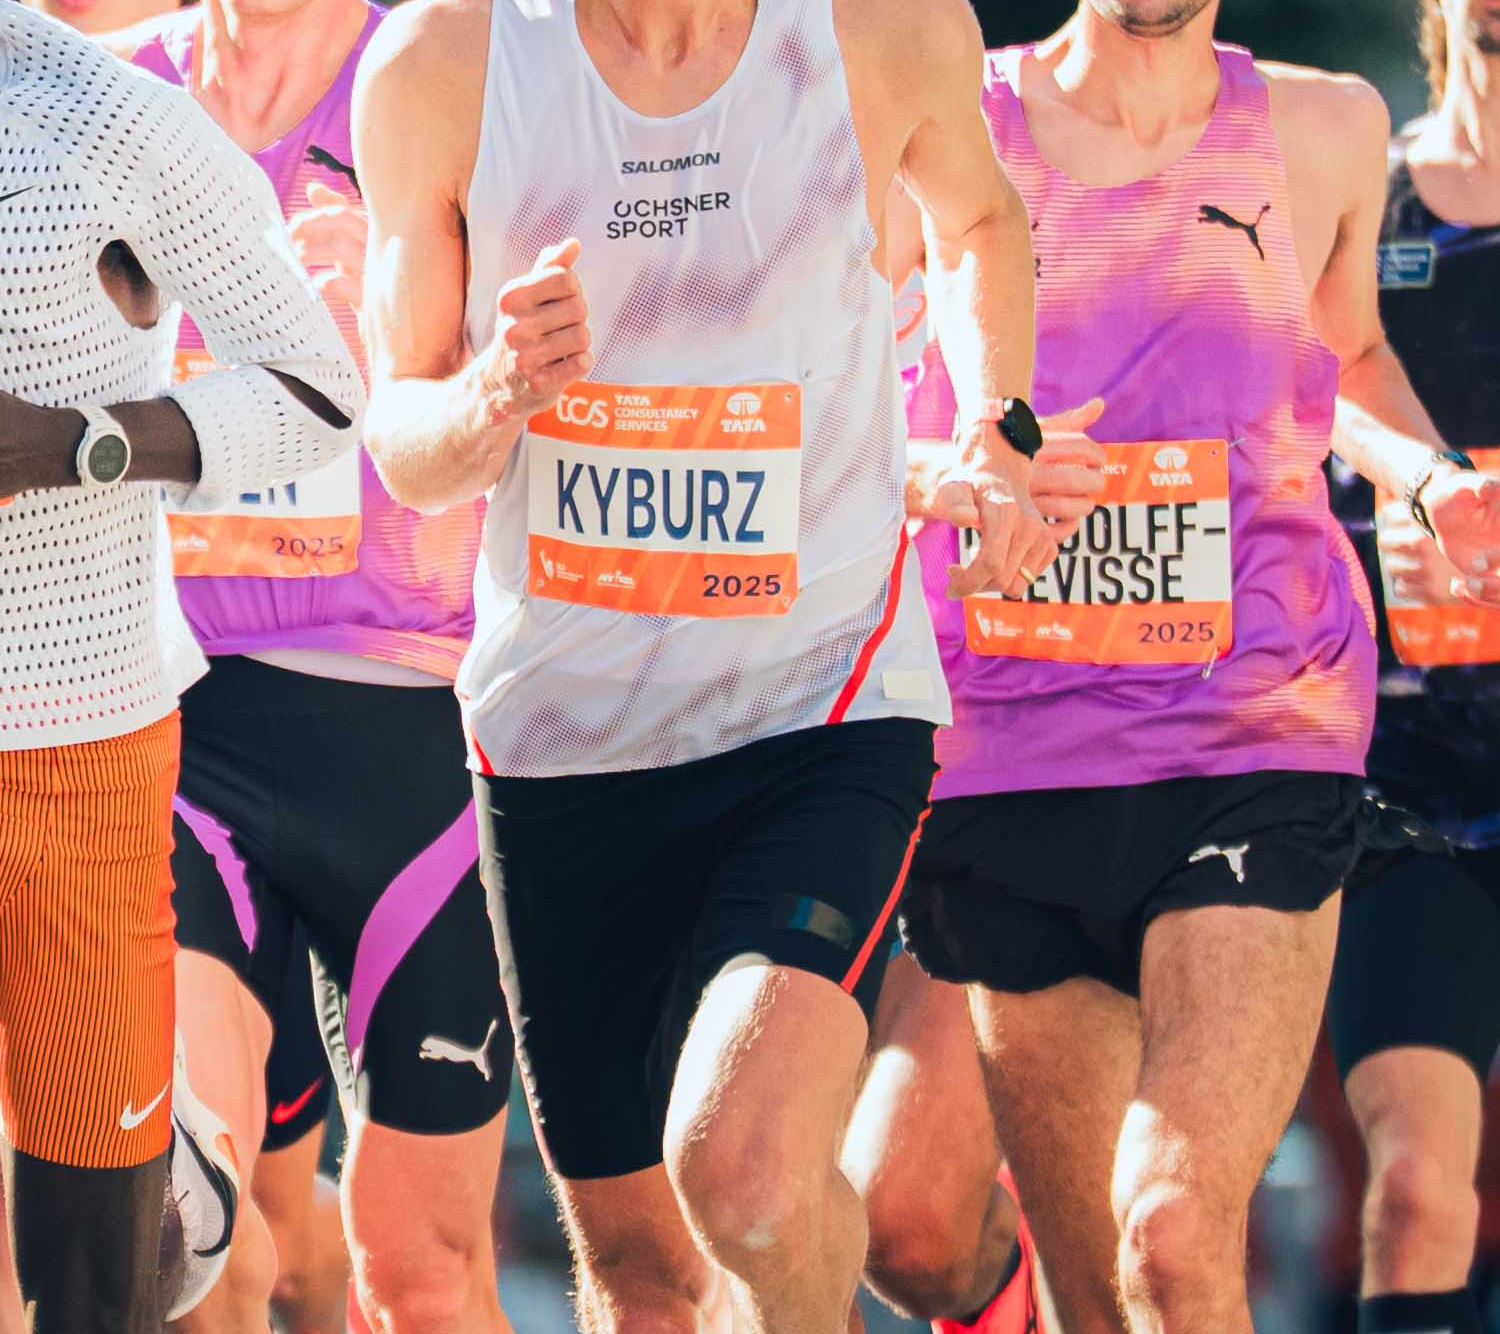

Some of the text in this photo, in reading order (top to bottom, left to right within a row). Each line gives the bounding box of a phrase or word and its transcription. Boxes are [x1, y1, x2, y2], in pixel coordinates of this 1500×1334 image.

[621, 152, 720, 174] SALOMON
[613, 191, 730, 218] OCHSNER
[606, 218, 688, 239] SPORT
[615, 394, 650, 406] TATA
[614, 407, 699, 420] CONSULTANCY
[614, 419, 668, 432] SERVICES
[721, 419, 766, 433] TATA
[1149, 472, 1193, 486] TATA
[557, 459, 766, 543] KYBURZ
[272, 536, 345, 557] 2025
[702, 573, 782, 598] 2025
[1001, 554, 1185, 605] EVISSE
[1138, 621, 1216, 644] 2025
